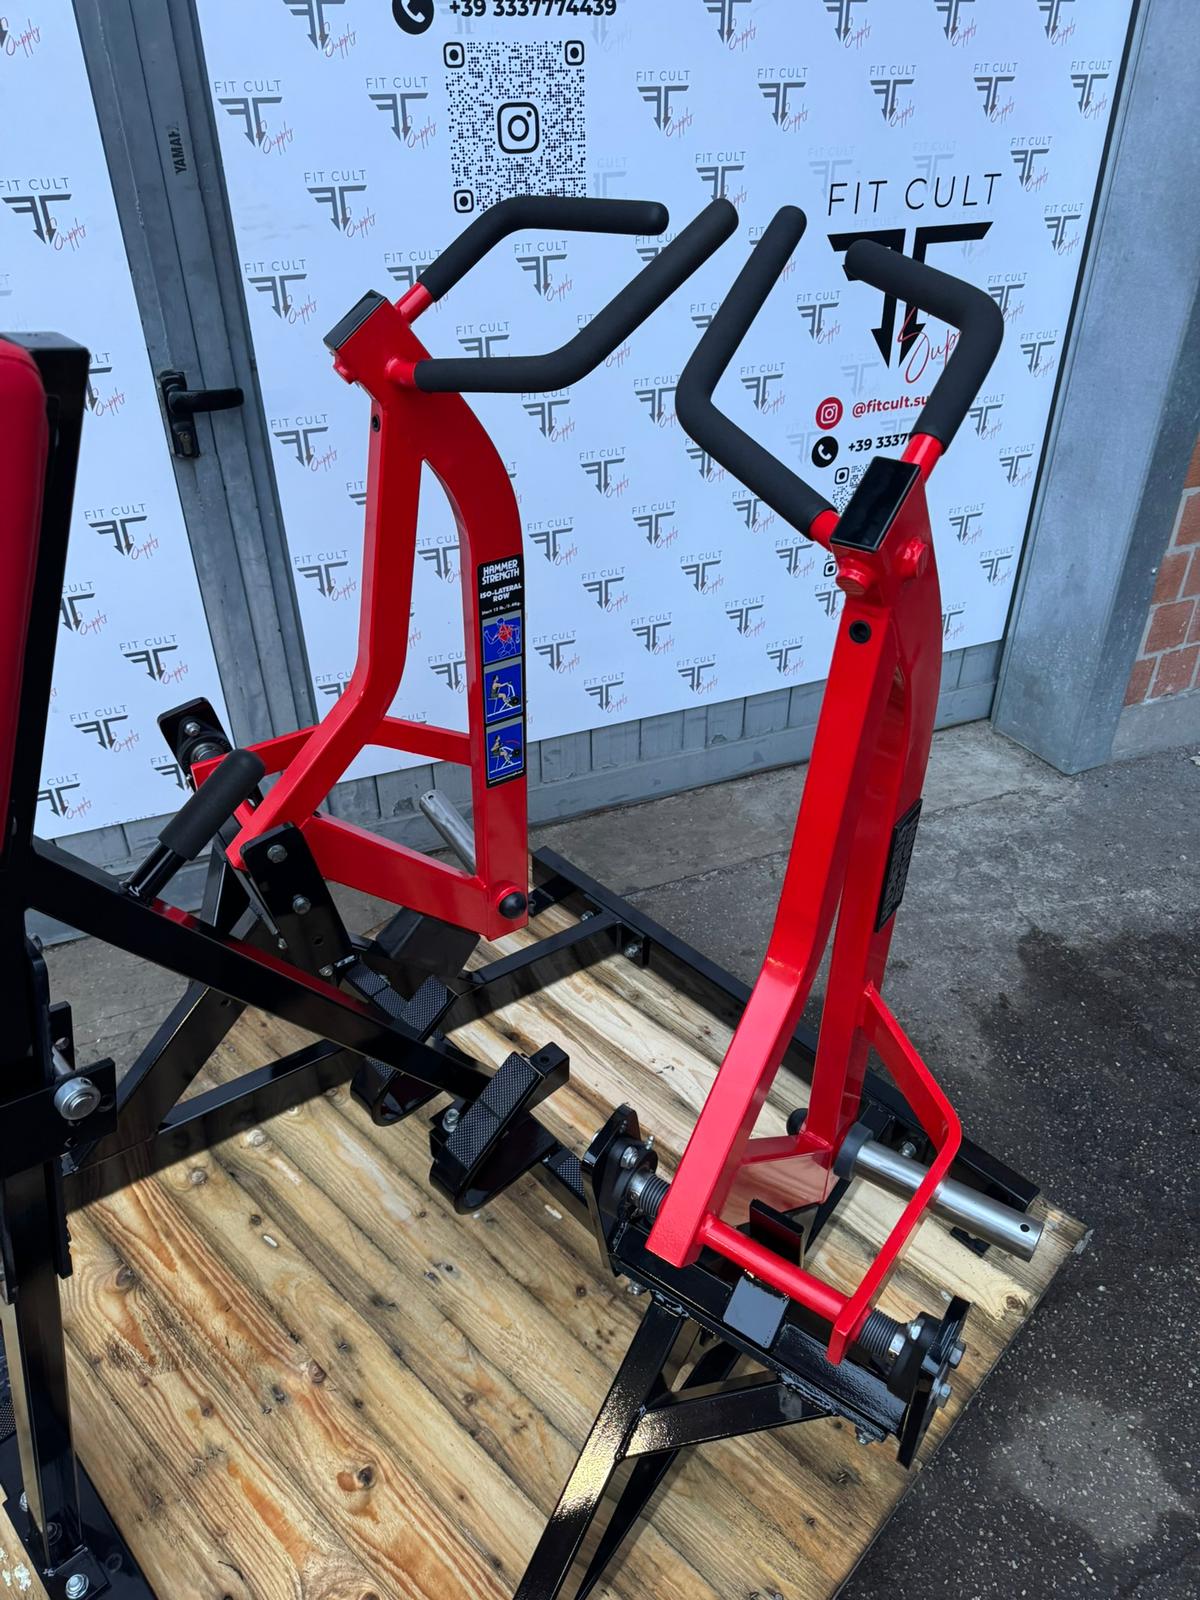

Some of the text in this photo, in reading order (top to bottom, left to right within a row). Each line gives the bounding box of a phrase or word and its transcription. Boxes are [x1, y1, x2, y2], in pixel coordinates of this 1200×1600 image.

[449, 0, 617, 17] +39 3337774439
[870, 65, 917, 76] FIT CULT
[973, 62, 1018, 73] FIT CULT
[1070, 60, 1112, 71] FIT CULT
[636, 70, 690, 82] FIT CULT
[757, 67, 808, 79] FIT CULT
[214, 80, 281, 93] FIT CULT
[366, 76, 428, 89] FIT CULT
[1010, 136, 1053, 147] FIT CULT
[695, 151, 746, 163] FIT CULT
[304, 169, 366, 184] FIT CULT
[28, 177, 69, 190] CULT
[828, 173, 1002, 216] FIT CULT
[1044, 203, 1084, 214] FIT CULT
[514, 240, 568, 254] FIT CULT
[384, 252, 403, 263] FIT
[244, 259, 306, 273] FIT CULT
[987, 272, 1028, 284] FIT CULT
[795, 290, 841, 303] FIT CULT
[690, 303, 707, 313] FIT
[456, 321, 509, 336] FIT CULT
[1020, 329, 1059, 341] FIT CULT
[897, 306, 962, 384] Sup
[740, 362, 785, 375] FIT CULT
[634, 377, 649, 388] FIT
[983, 394, 1006, 403] CULT
[852, 396, 930, 418] @fitcult.su
[270, 414, 328, 429] FIT CULT
[848, 433, 910, 452] +39 3337
[579, 446, 626, 461] FIT CULT
[999, 443, 1036, 456] FIT CULT
[346, 480, 364, 491] FIT
[732, 490, 747, 499] FIT
[84, 503, 145, 520] FIT CULT
[632, 500, 676, 514] FIT CULT
[948, 502, 986, 516] FIT CULT
[527, 517, 574, 531] FIT CULT
[775, 539, 789, 548] FIT
[294, 550, 348, 565] FIT CULT
[680, 550, 723, 564] FIT CULT
[979, 546, 1014, 559] FIT CULT
[483, 559, 518, 576] HAMMER
[581, 566, 625, 581] FIT CULT
[481, 567, 520, 585] STRENGTH
[480, 583, 522, 599] ISO-LATERAL
[814, 583, 828, 592] FIT
[493, 592, 510, 602] ROW
[725, 595, 765, 608] FIT CULT
[946, 602, 967, 611] CULT
[630, 612, 672, 626] FIT CULT
[119, 634, 176, 651] FIT CULT
[532, 631, 576, 645] FIT CULT
[766, 636, 803, 650] FIT CULT
[428, 654, 443, 664] FIT
[676, 654, 716, 667] FIT CULT
[315, 674, 333, 684] FIT
[584, 672, 624, 686] FIT CULT
[69, 705, 127, 722] FIT CULT
[150, 755, 168, 765] FIT
[47, 773, 78, 786] CULT
